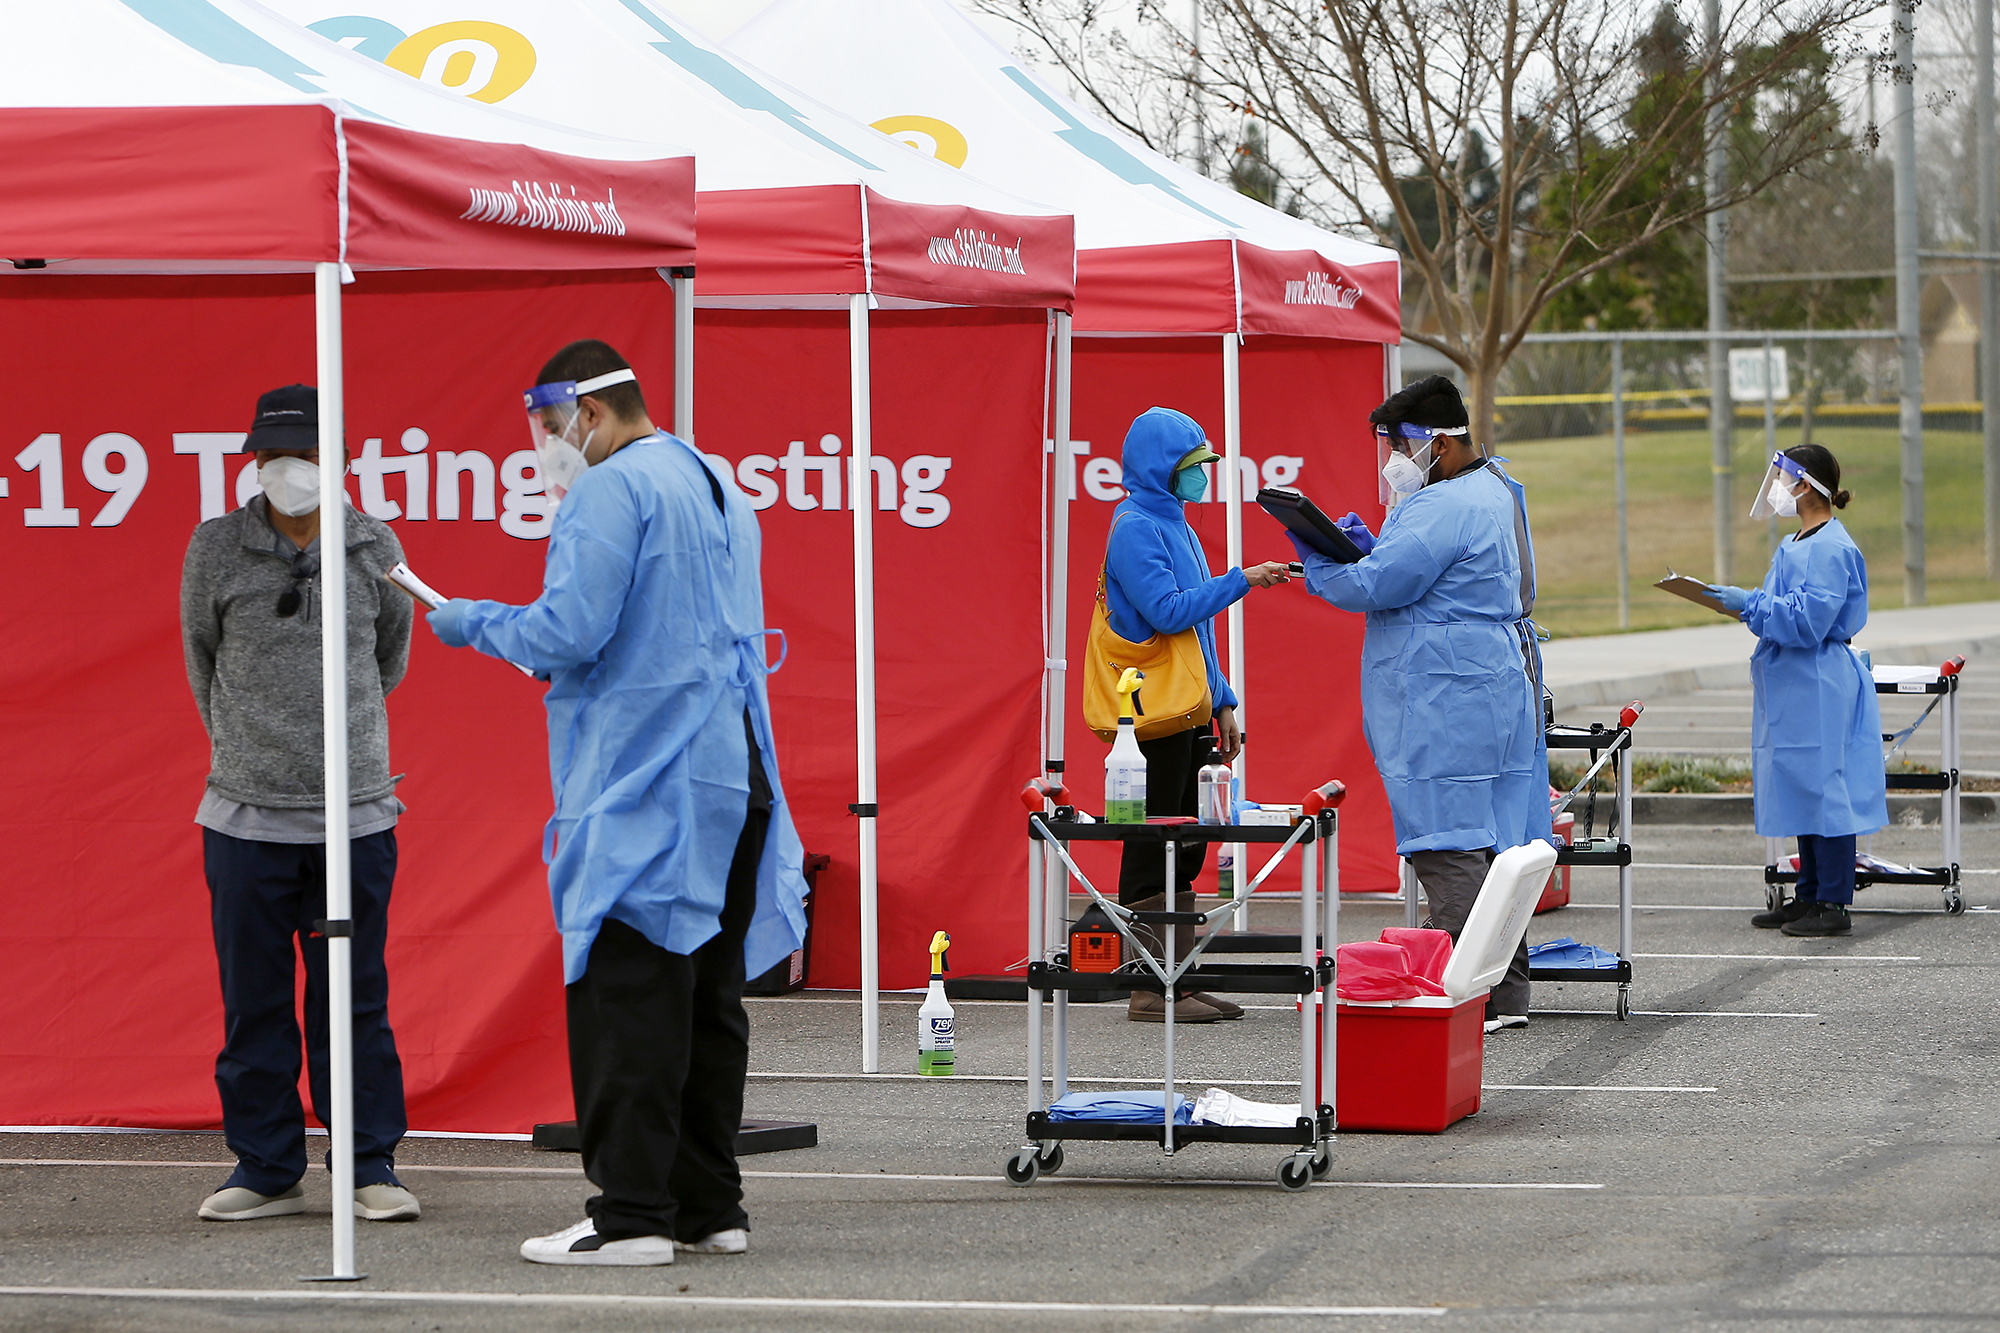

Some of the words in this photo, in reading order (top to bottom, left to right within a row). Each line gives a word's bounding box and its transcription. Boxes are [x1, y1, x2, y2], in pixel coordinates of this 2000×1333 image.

[459, 179, 626, 236] www.360clinic.md
[927, 227, 1027, 275] www.360clinic.md
[0, 432, 149, 527] 19
[172, 427, 560, 540] Tting
[702, 433, 952, 529] sting
[1047, 438, 1304, 504] Teng
